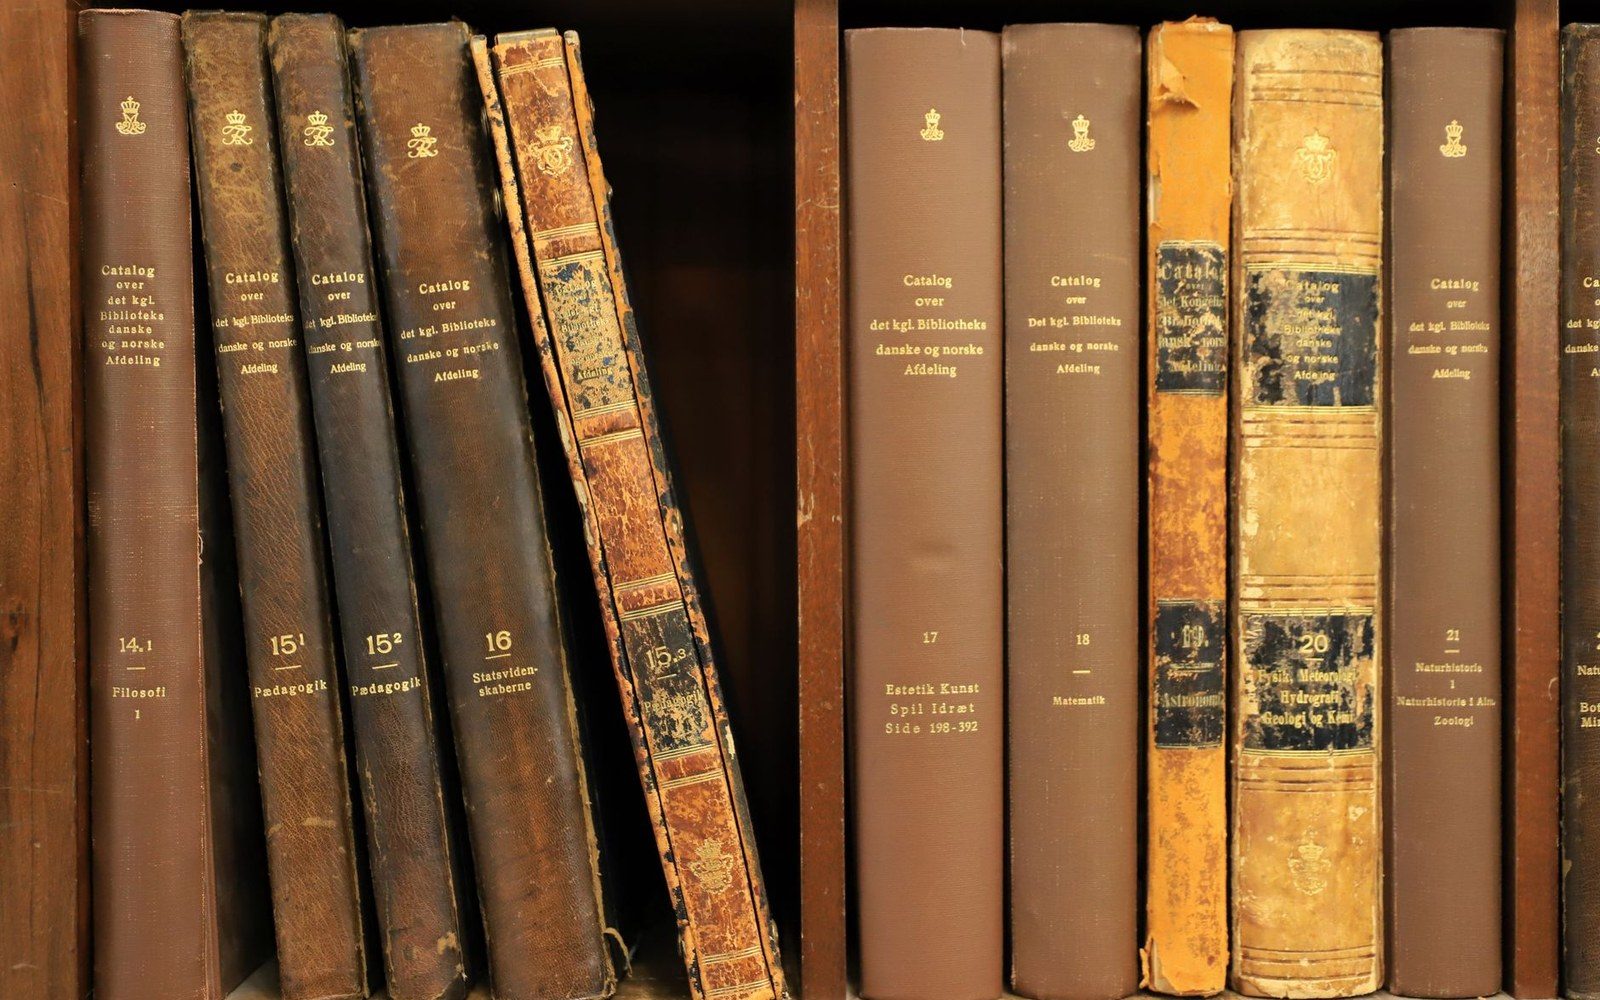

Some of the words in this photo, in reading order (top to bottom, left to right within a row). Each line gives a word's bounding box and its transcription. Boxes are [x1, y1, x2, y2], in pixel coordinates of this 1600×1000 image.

[102, 265, 155, 278] Catalog
[225, 272, 279, 284] Catalog
[312, 271, 364, 286] Catalog
[903, 275, 952, 289] Catalog
[1051, 275, 1101, 288] Catalog
[116, 281, 144, 289] over
[419, 279, 470, 295] Catalog
[1431, 278, 1479, 291] Catalog
[108, 296, 126, 305] det
[241, 292, 264, 302] over
[328, 291, 351, 301] over
[915, 296, 944, 307] over
[1066, 296, 1087, 305] over
[433, 300, 456, 311] over
[1447, 300, 1467, 308] over
[100, 311, 164, 321] Biblioteks
[216, 318, 229, 328] det
[251, 313, 294, 324] Biblioteks
[400, 328, 415, 340] det
[419, 325, 438, 339] kgl.
[442, 317, 496, 333] Biblioteks
[870, 319, 890, 331] det
[893, 319, 915, 333] kgl.
[918, 319, 986, 331] Bibliotheks
[1028, 317, 1046, 328] Det
[1050, 316, 1069, 329] kgl.
[1072, 316, 1121, 327] Biblioteks
[1409, 321, 1425, 332] det
[1566, 319, 1582, 328] det
[109, 325, 152, 334] danske
[102, 341, 115, 350] og
[122, 340, 165, 349] norske
[218, 342, 247, 353] danske
[252, 342, 264, 351] og
[341, 342, 352, 352] og
[876, 344, 921, 356] danske
[924, 345, 940, 358] og
[943, 344, 983, 356] norske
[1030, 342, 1065, 352] danske
[1070, 343, 1083, 353] og
[1087, 341, 1119, 352] norske
[1408, 344, 1441, 354] danske
[1445, 345, 1458, 355] og
[1564, 343, 1599, 354] danske
[406, 350, 442, 363] danske
[446, 348, 459, 359] og
[463, 340, 499, 354] norske
[106, 355, 161, 367] Afdeling
[1287, 354, 1300, 364] og
[241, 363, 278, 375] Afdeling
[330, 362, 367, 374] Afdeling
[904, 363, 957, 377] Afdeling
[1056, 363, 1100, 375] Afdeling
[1432, 368, 1471, 380] Afdeling
[434, 368, 479, 383] Afdeling
[485, 630, 512, 652] 16
[923, 632, 938, 644] 17
[1075, 634, 1090, 645] 18
[1446, 629, 1460, 641] 21
[1300, 634, 1329, 653] 20
[1415, 662, 1482, 673] Naturhistorie
[472, 665, 539, 684] Statsviden-
[112, 686, 166, 698] Filosofi
[254, 679, 327, 698] Pædagogik
[352, 676, 421, 697] Pædagogik
[479, 680, 532, 698] skaberne
[886, 684, 935, 696] Estetik
[940, 683, 979, 695] Kunst
[1053, 695, 1105, 706] Matematik
[1396, 696, 1467, 707] Naturhistorie
[890, 703, 923, 717] Spil
[932, 703, 975, 715] Idræt
[1261, 711, 1306, 728] Geologi
[1311, 714, 1323, 728] og
[1434, 715, 1474, 728] Zoologi
[885, 723, 921, 734] Side
[930, 721, 978, 733] 198-392
